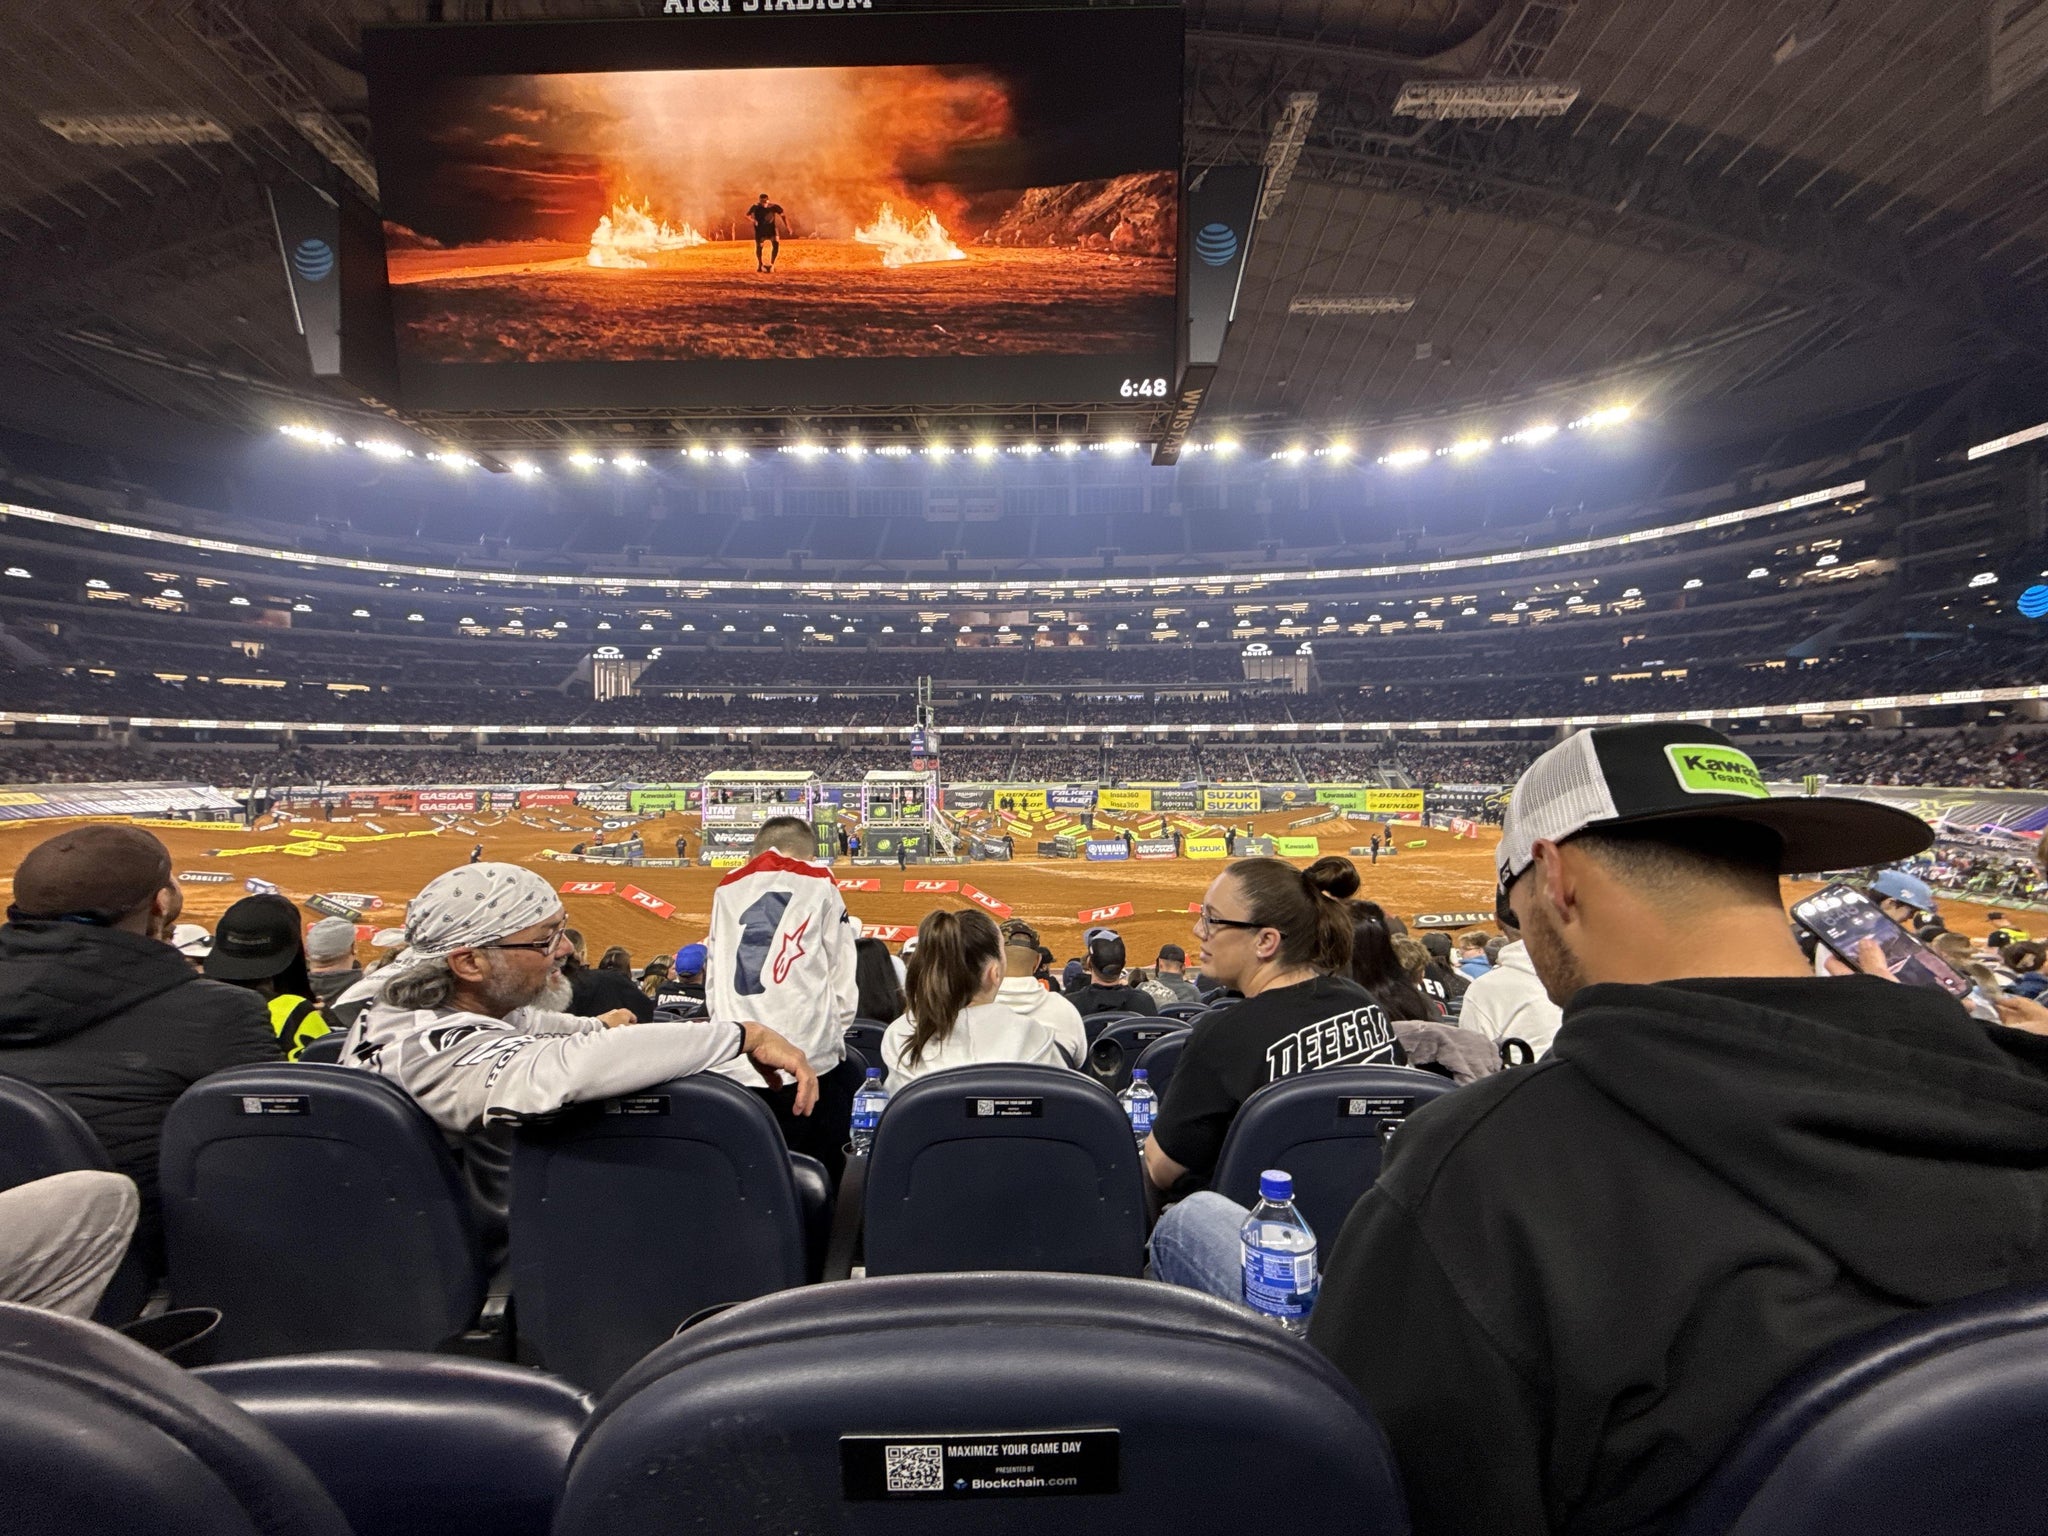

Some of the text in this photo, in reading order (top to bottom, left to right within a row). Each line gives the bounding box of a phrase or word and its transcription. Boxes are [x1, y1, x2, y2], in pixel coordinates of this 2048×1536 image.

[1120, 378, 1167, 397] 6:48
[1683, 755, 1757, 777] Kawa
[1708, 771, 1748, 785] Team
[419, 792, 474, 800] GASGAS
[1207, 791, 1258, 799] SUZUKI
[419, 803, 474, 811] GASGAS
[768, 806, 807, 815] MILITAR
[1097, 844, 1127, 853] YAMAHA
[571, 882, 602, 892] FLY
[838, 880, 868, 889] FLY
[915, 881, 947, 890] FLY
[633, 890, 664, 909] FLY
[973, 891, 999, 908] FLY
[1091, 905, 1120, 920] FLY
[1443, 913, 1495, 922] OAKLE
[861, 925, 901, 940] FLY
[1133, 1113, 1150, 1124] BLUE
[948, 1441, 1082, 1457] MAXIMIZE YOUR GAME DAY
[972, 1476, 1077, 1489] Blockchain.com
